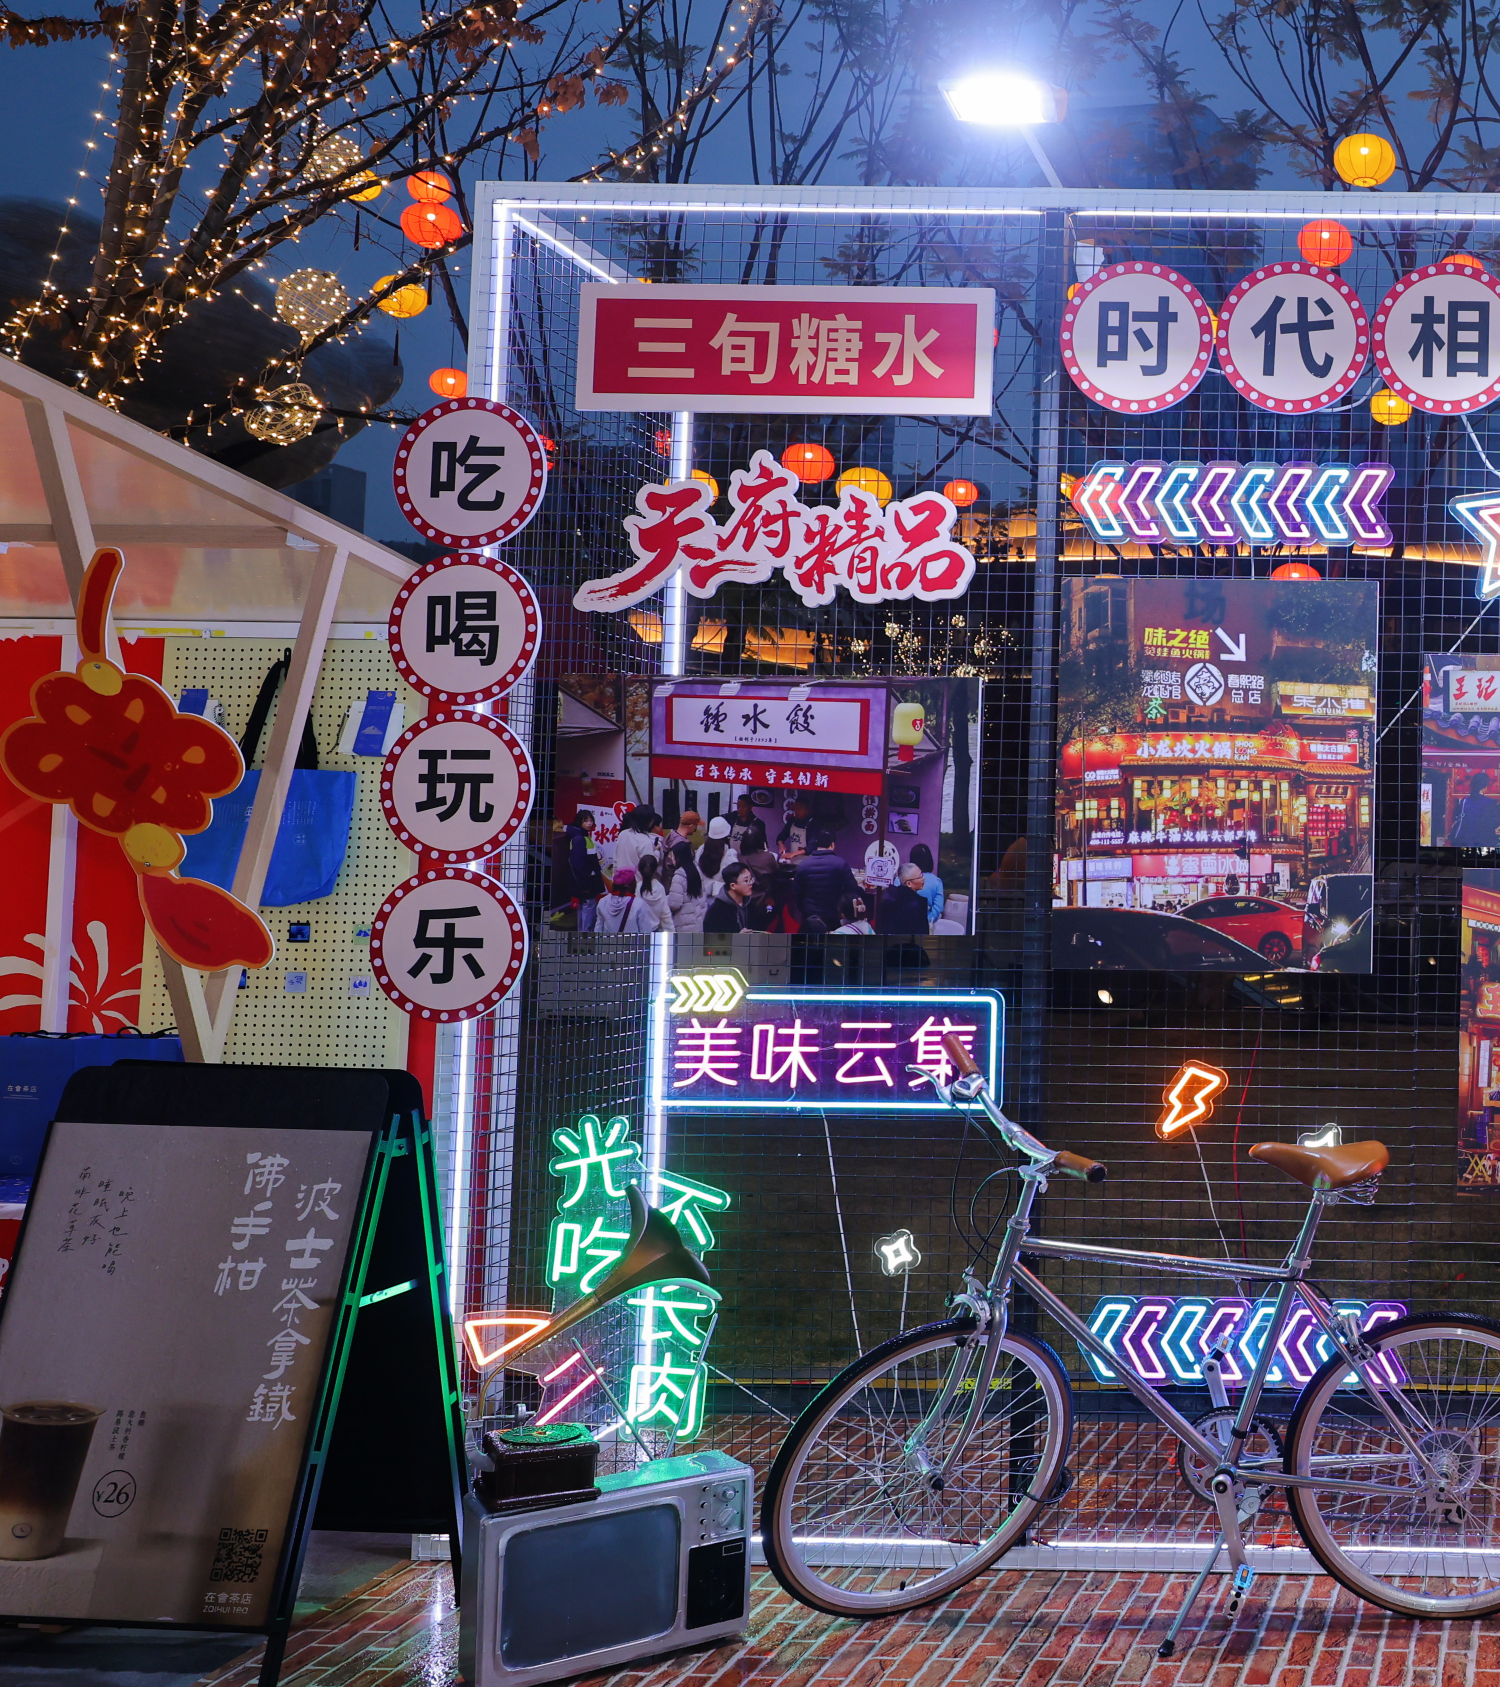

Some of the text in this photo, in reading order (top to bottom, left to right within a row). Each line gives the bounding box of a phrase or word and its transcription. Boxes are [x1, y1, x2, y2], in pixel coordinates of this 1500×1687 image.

[627, 311, 945, 387] 三旬糖水
[587, 457, 965, 602] 天府精品
[1144, 627, 1210, 649] 味之绝
[1227, 674, 1265, 689] 春熙路
[1231, 690, 1262, 704] 总店
[407, 434, 506, 985] 吃喝玩乐
[1136, 739, 1232, 759] 小龙坎火锅
[695, 764, 829, 788] 百年传承 守正创新
[672, 1015, 978, 1088] 美味云集
[214, 1152, 290, 1296] 佛手柑
[204, 1592, 253, 1605] 在會茶店
